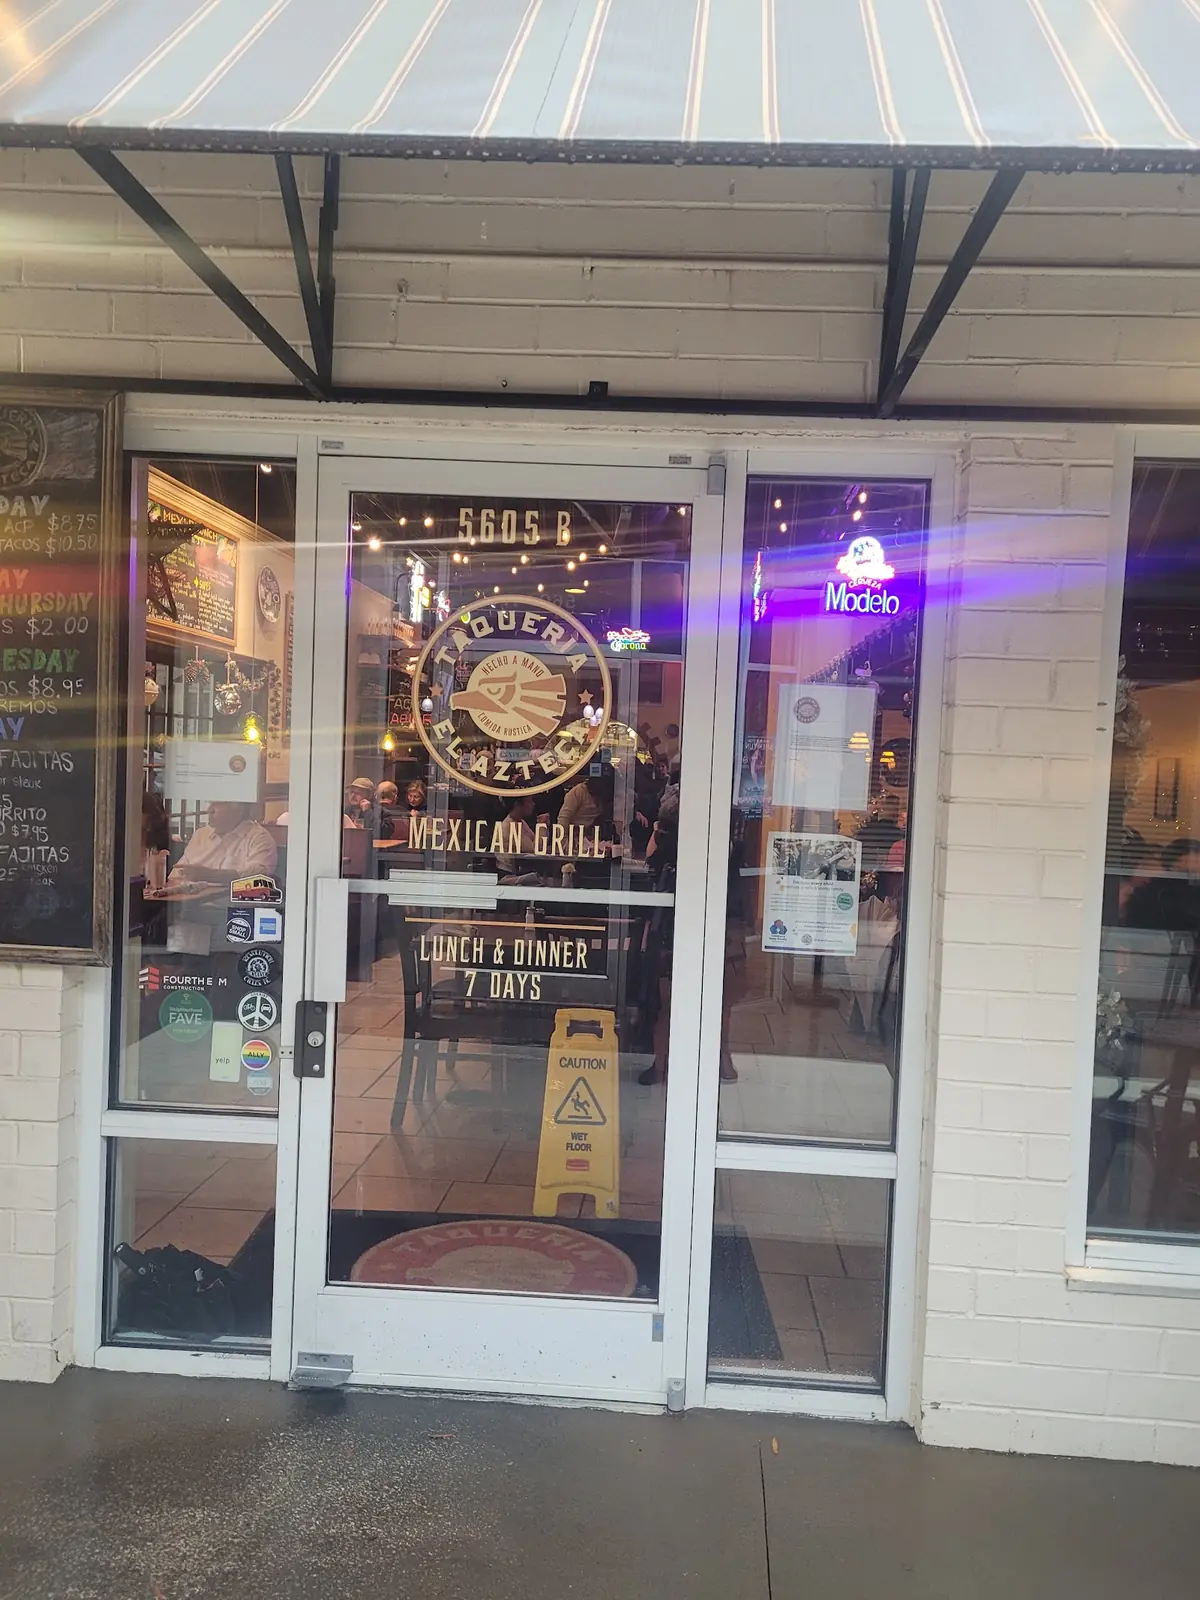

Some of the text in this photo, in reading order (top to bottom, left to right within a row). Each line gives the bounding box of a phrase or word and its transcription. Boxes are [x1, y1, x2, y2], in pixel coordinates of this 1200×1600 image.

[0, 495, 50, 517] DAY
[458, 508, 571, 547] 5605 B
[0, 533, 98, 559] TACOS $10.50
[825, 581, 900, 615] Modelo
[434, 610, 589, 675] TAQUERIA
[610, 640, 647, 652] Corona
[481, 655, 545, 678] HECHO A MANO
[477, 712, 533, 737] COMIDA RUSTICA
[432, 718, 589, 782] EL AZTECA
[408, 816, 608, 859] MEXICAN GRILL
[228, 928, 247, 938] SMALL
[231, 924, 247, 932] SHOP
[420, 935, 588, 969] LUNCH & DINNER
[464, 971, 541, 1000] 7 DAYS
[169, 1012, 203, 1025] FAVE
[215, 1056, 230, 1065] yelp
[247, 1051, 265, 1059] ALLY
[559, 1056, 607, 1070] CAUTION
[566, 1142, 592, 1152] FLOOR
[571, 1132, 588, 1142] WET
